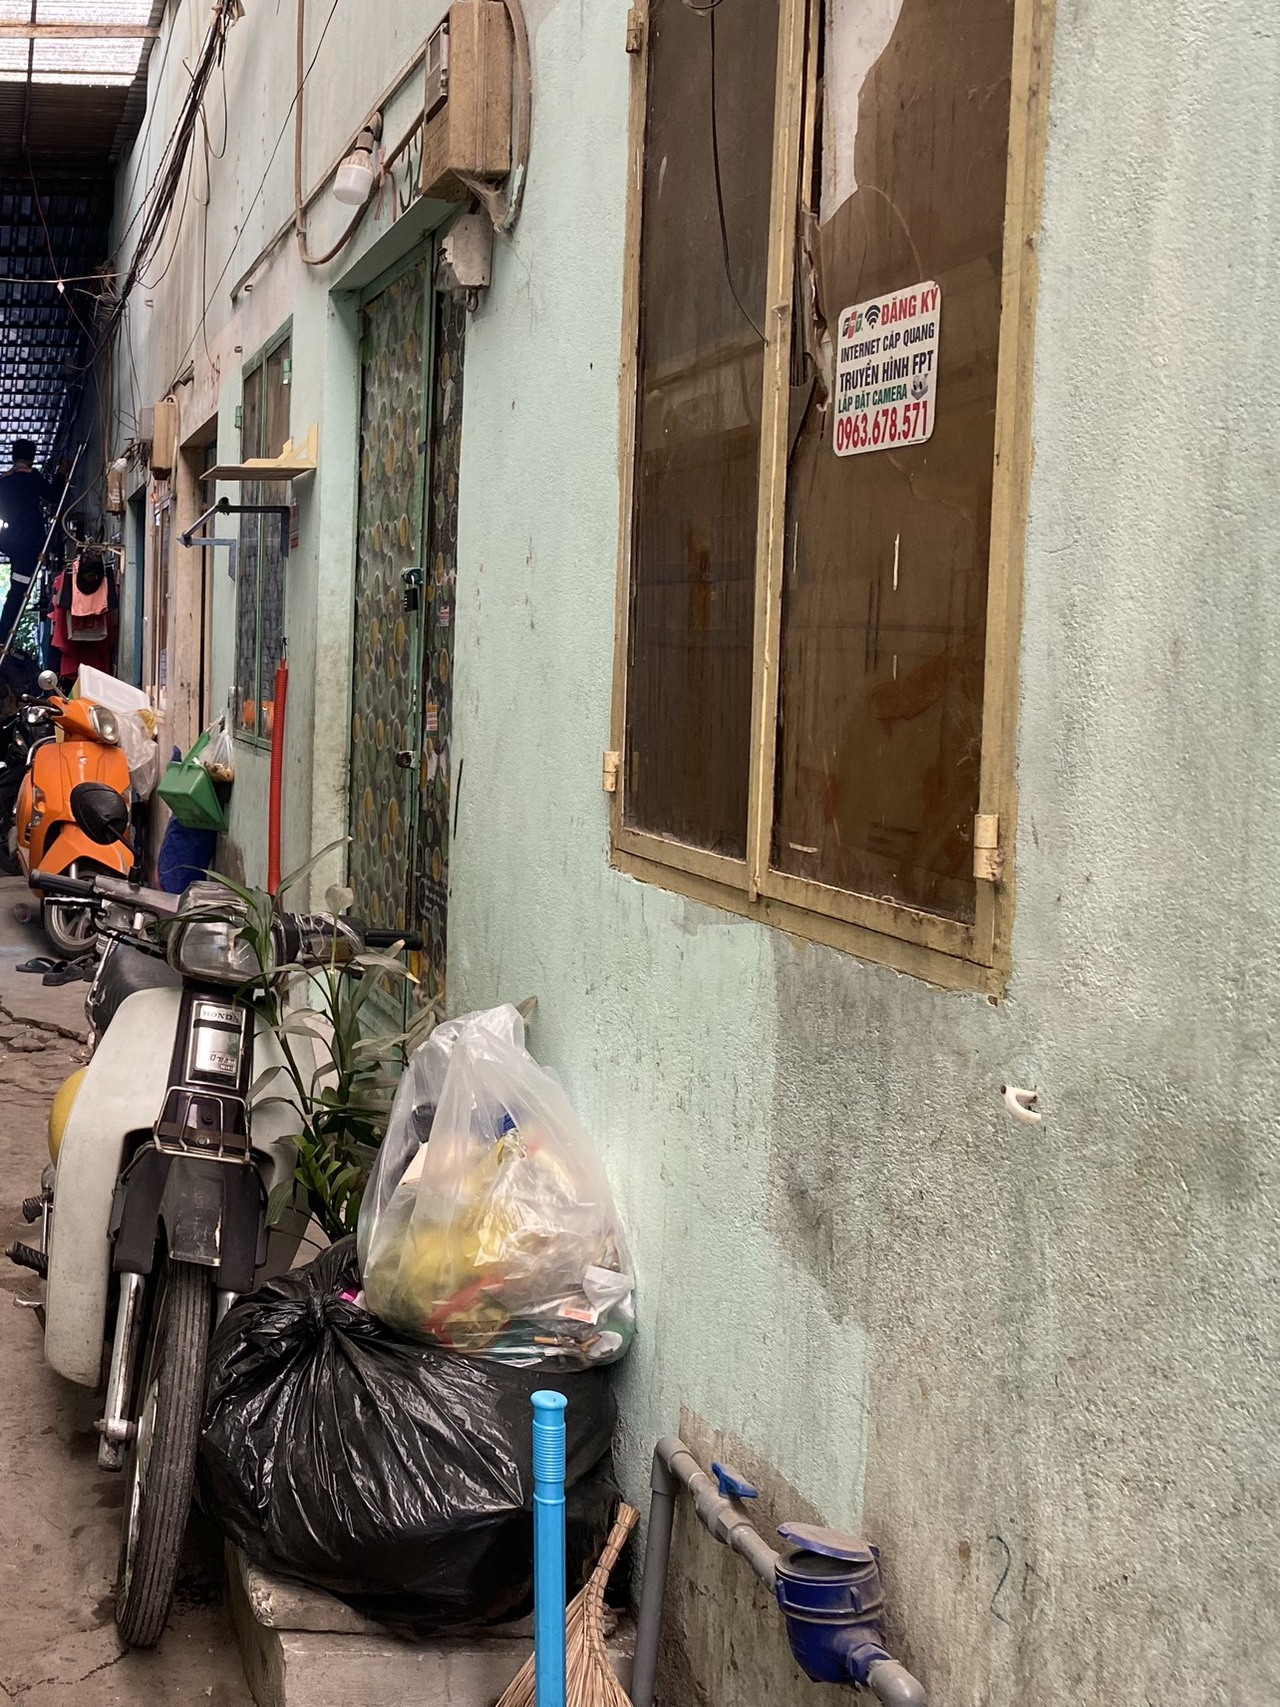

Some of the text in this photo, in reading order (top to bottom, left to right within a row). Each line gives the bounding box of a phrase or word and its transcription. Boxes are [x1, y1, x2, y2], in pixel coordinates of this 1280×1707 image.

[881, 295, 917, 325] ĐĂNG
[921, 282, 939, 314] KÝ
[841, 322, 935, 363] INTERNET CÁP QUANG
[840, 349, 934, 392] TRUYỀN HÌNH FPT
[872, 383, 907, 405] CAMERA
[836, 400, 928, 451] 0963.678.571
[202, 1010, 239, 1022] HONDA
